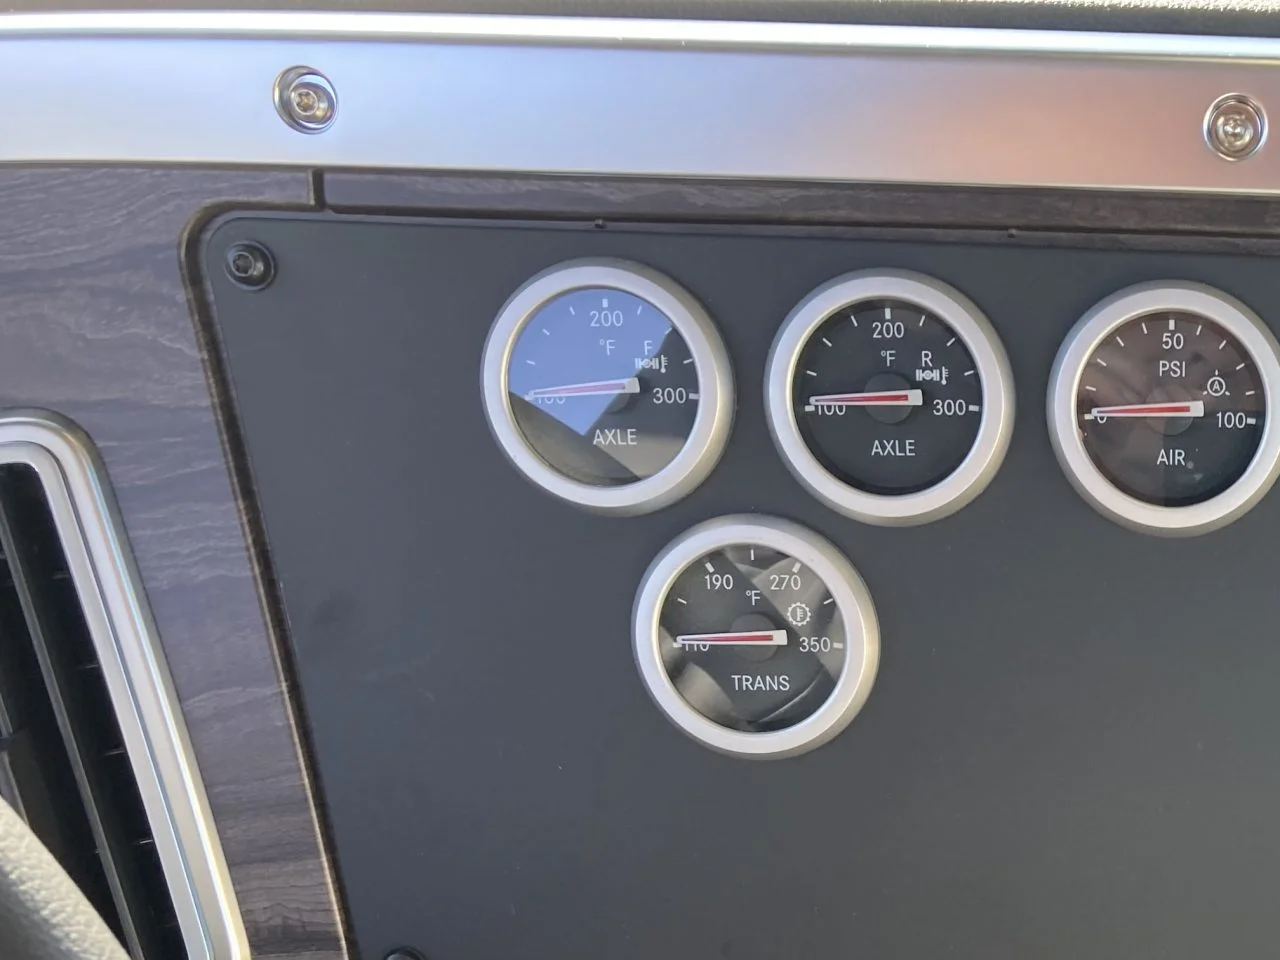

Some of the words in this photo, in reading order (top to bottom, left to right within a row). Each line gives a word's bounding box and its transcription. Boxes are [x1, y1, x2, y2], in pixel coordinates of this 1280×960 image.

[589, 310, 624, 327] 200
[872, 322, 905, 339] 200
[644, 340, 653, 355] F
[1161, 333, 1184, 350] 50
[921, 350, 933, 367] R
[1158, 360, 1186, 377] PSI
[652, 387, 687, 404] 300
[932, 399, 967, 416] 300
[1216, 411, 1246, 429] 100
[592, 429, 638, 445] AXLE
[871, 439, 916, 456] AXLE
[1156, 449, 1186, 466] AIR
[704, 574, 734, 590] 190
[769, 574, 801, 591] 270
[799, 637, 831, 652] 350
[731, 675, 790, 691] TRANS
